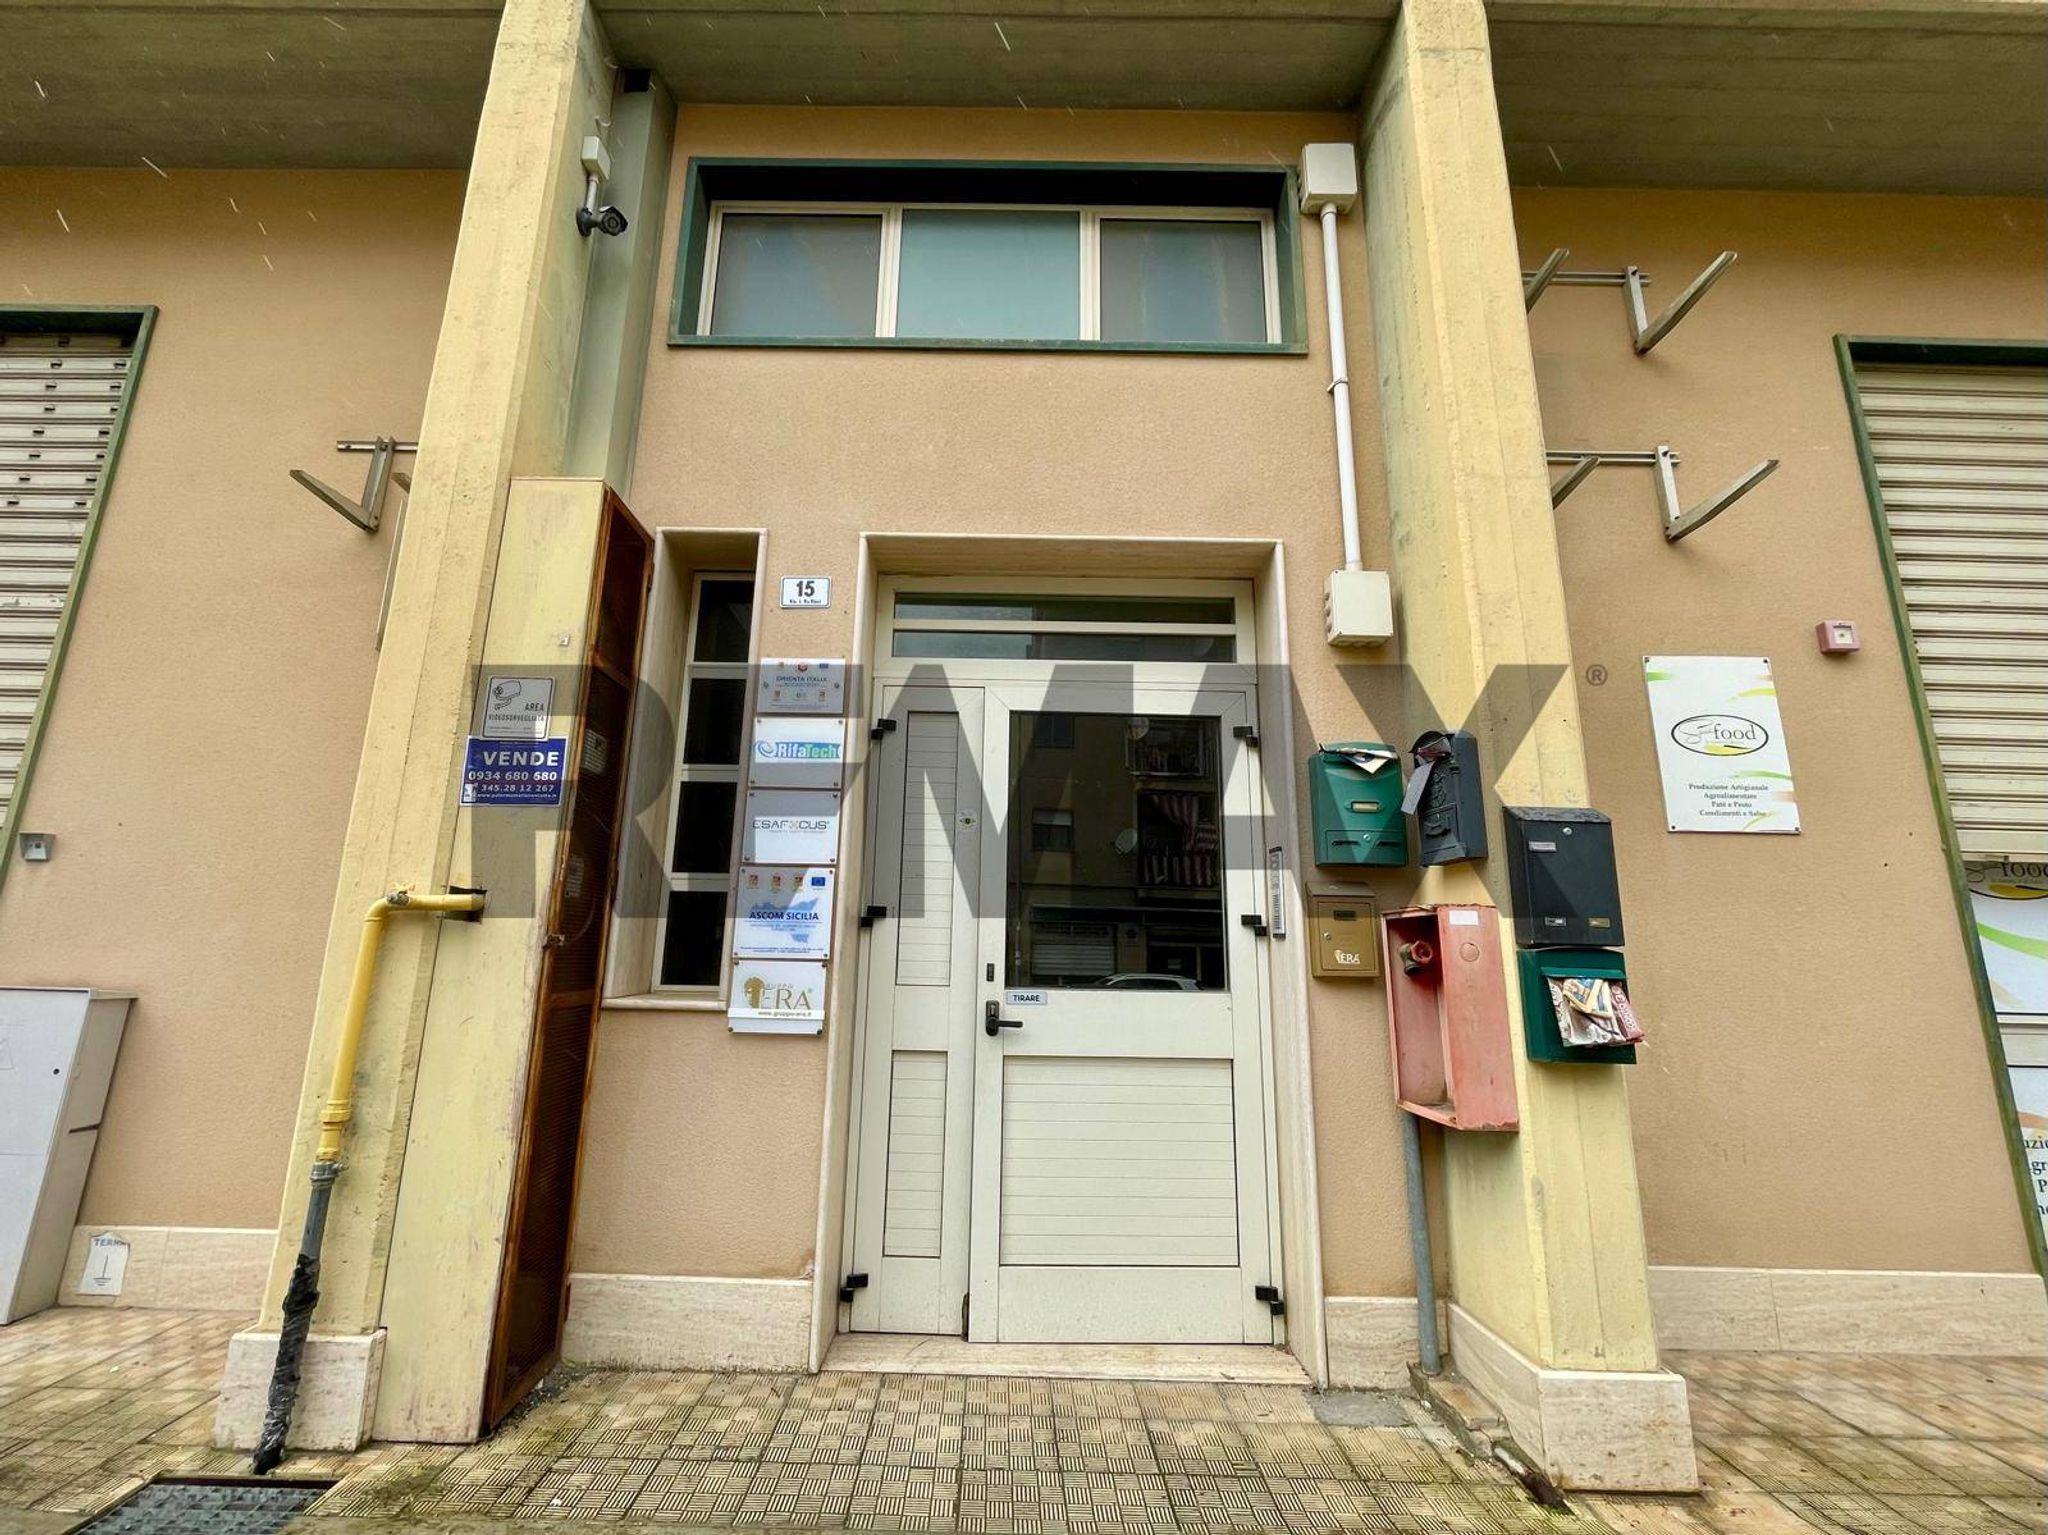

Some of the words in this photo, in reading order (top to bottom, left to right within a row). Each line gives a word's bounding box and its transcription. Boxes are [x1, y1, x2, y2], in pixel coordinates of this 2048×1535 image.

[796, 580, 815, 597] 15
[525, 702, 545, 711] AREA
[778, 742, 837, 758] RifaTech
[483, 751, 559, 766] VENDE
[468, 770, 501, 781] 0934
[505, 771, 529, 781] 680
[533, 771, 557, 781] 680
[481, 784, 516, 793] 345.28
[520, 784, 532, 793] 12
[536, 784, 555, 793] 267
[2001, 855, 2048, 878] foo
[749, 911, 784, 920] ASCOM
[786, 912, 819, 921] SICILIA
[1012, 994, 1040, 1002] TIRARE
